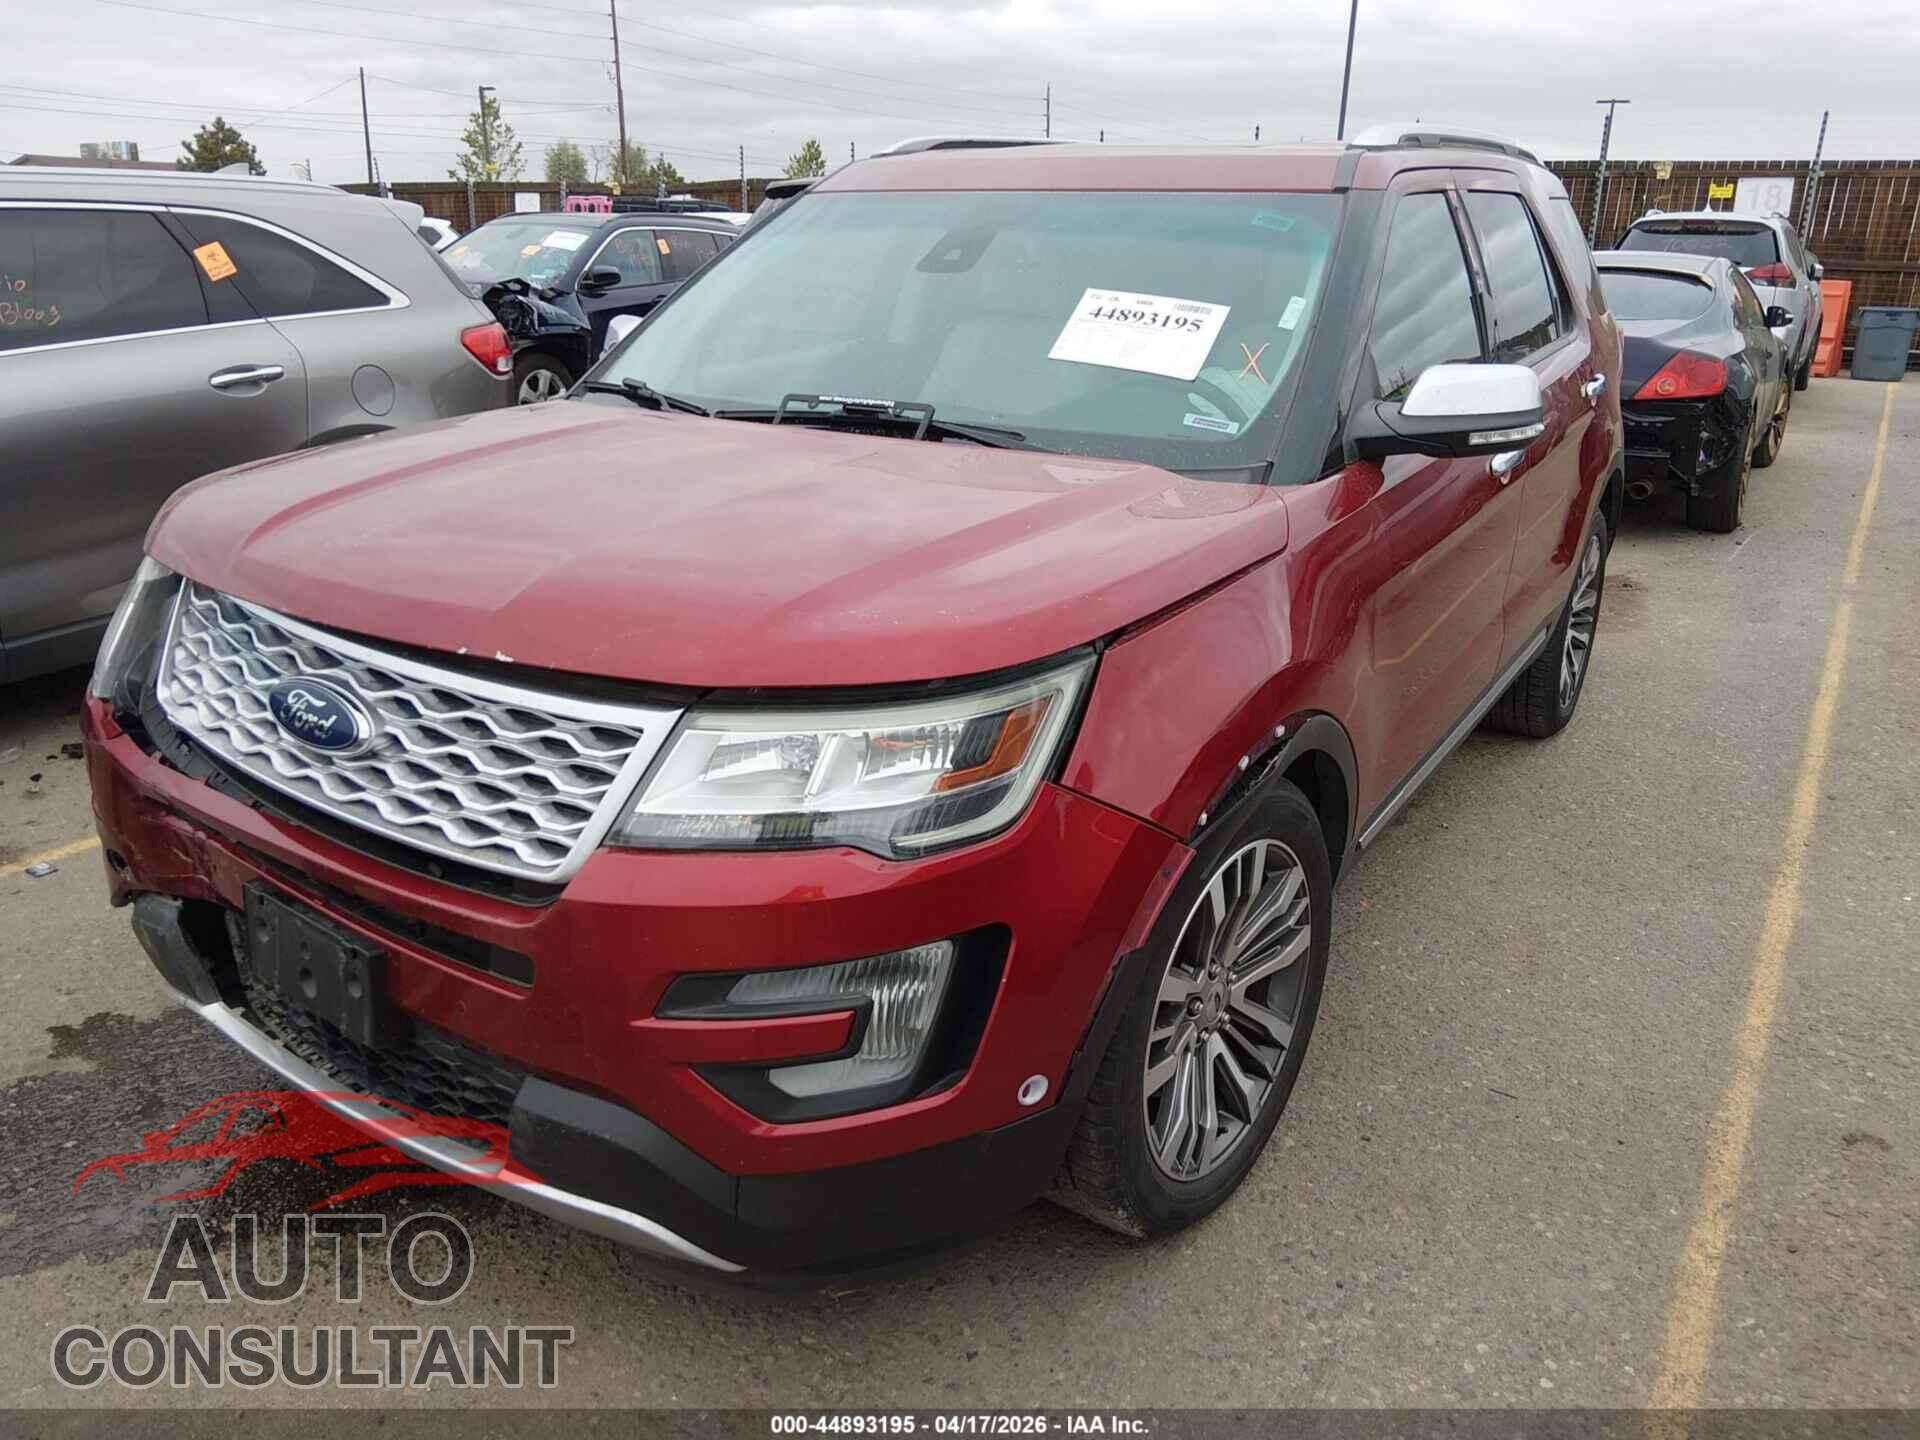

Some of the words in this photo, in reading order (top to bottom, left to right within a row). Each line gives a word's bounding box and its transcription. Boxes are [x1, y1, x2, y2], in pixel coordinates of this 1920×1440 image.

[1746, 183, 1784, 209] 18
[1088, 305, 1205, 333] 44893195
[284, 689, 339, 734] Ford
